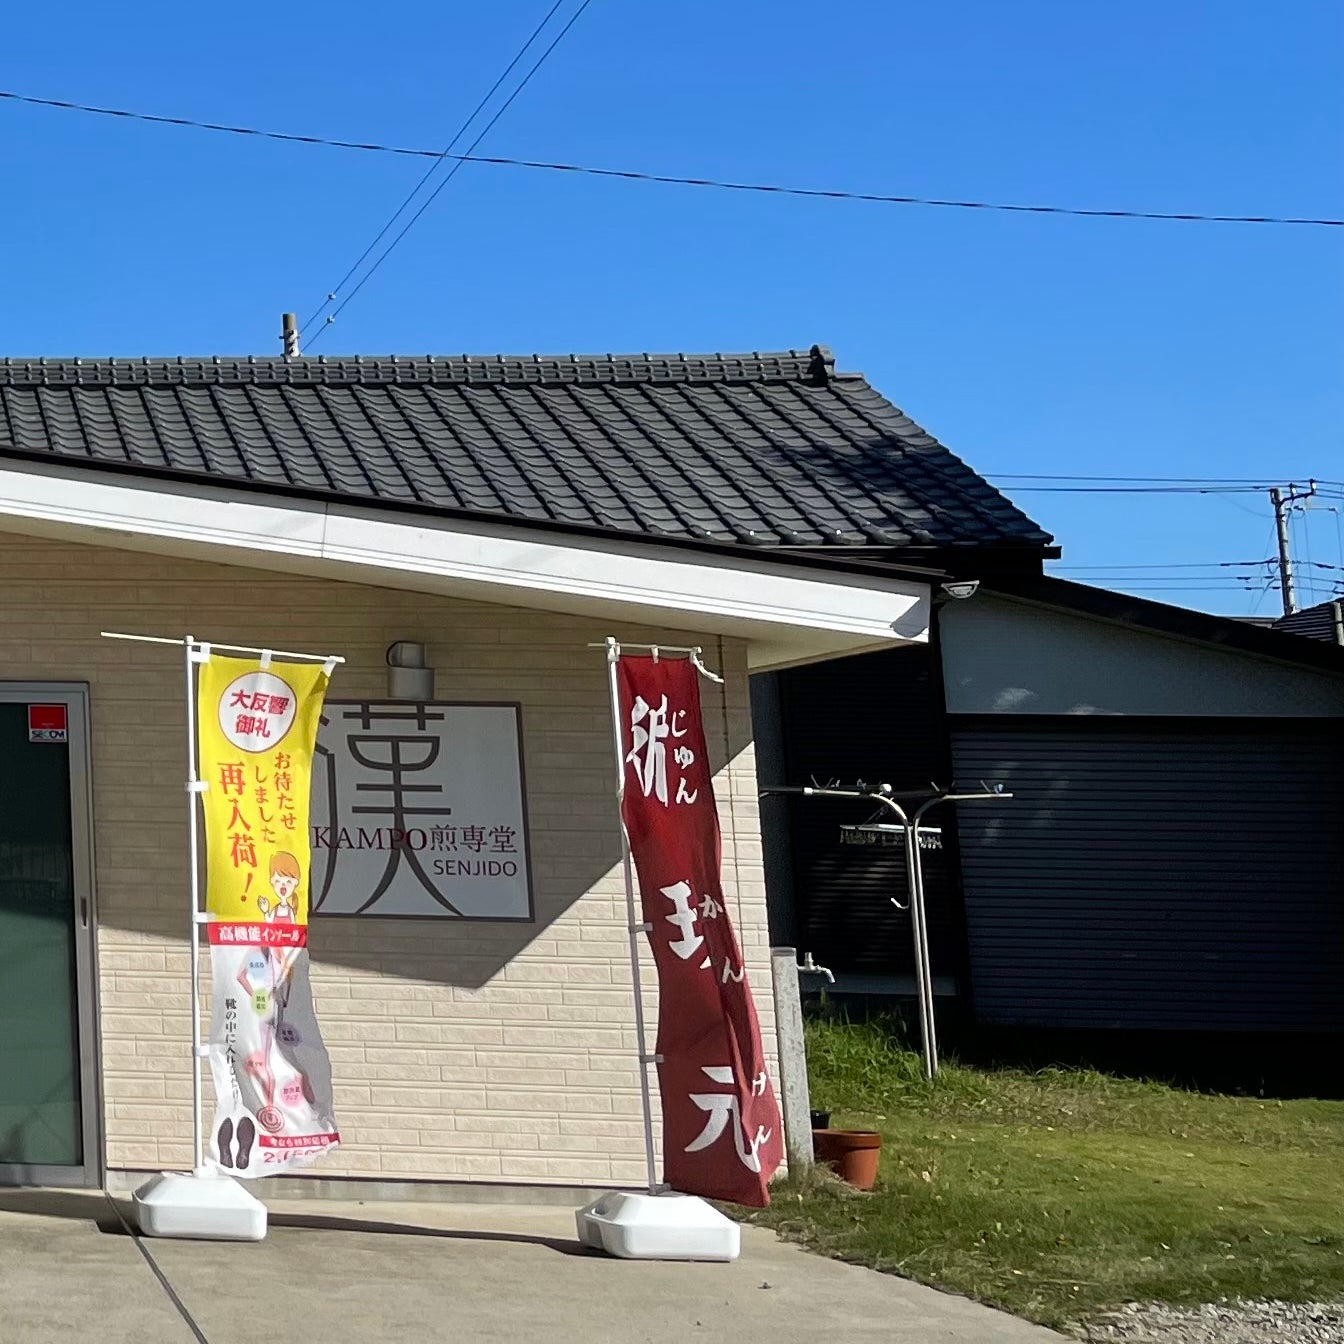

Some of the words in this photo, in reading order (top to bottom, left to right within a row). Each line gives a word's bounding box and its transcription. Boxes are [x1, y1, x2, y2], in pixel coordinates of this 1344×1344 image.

[230, 689, 289, 716] 大反響
[235, 714, 271, 738] 御礼
[255, 765, 276, 844] しました
[273, 752, 296, 831] お待たせ
[433, 859, 517, 876] SENJIDO
